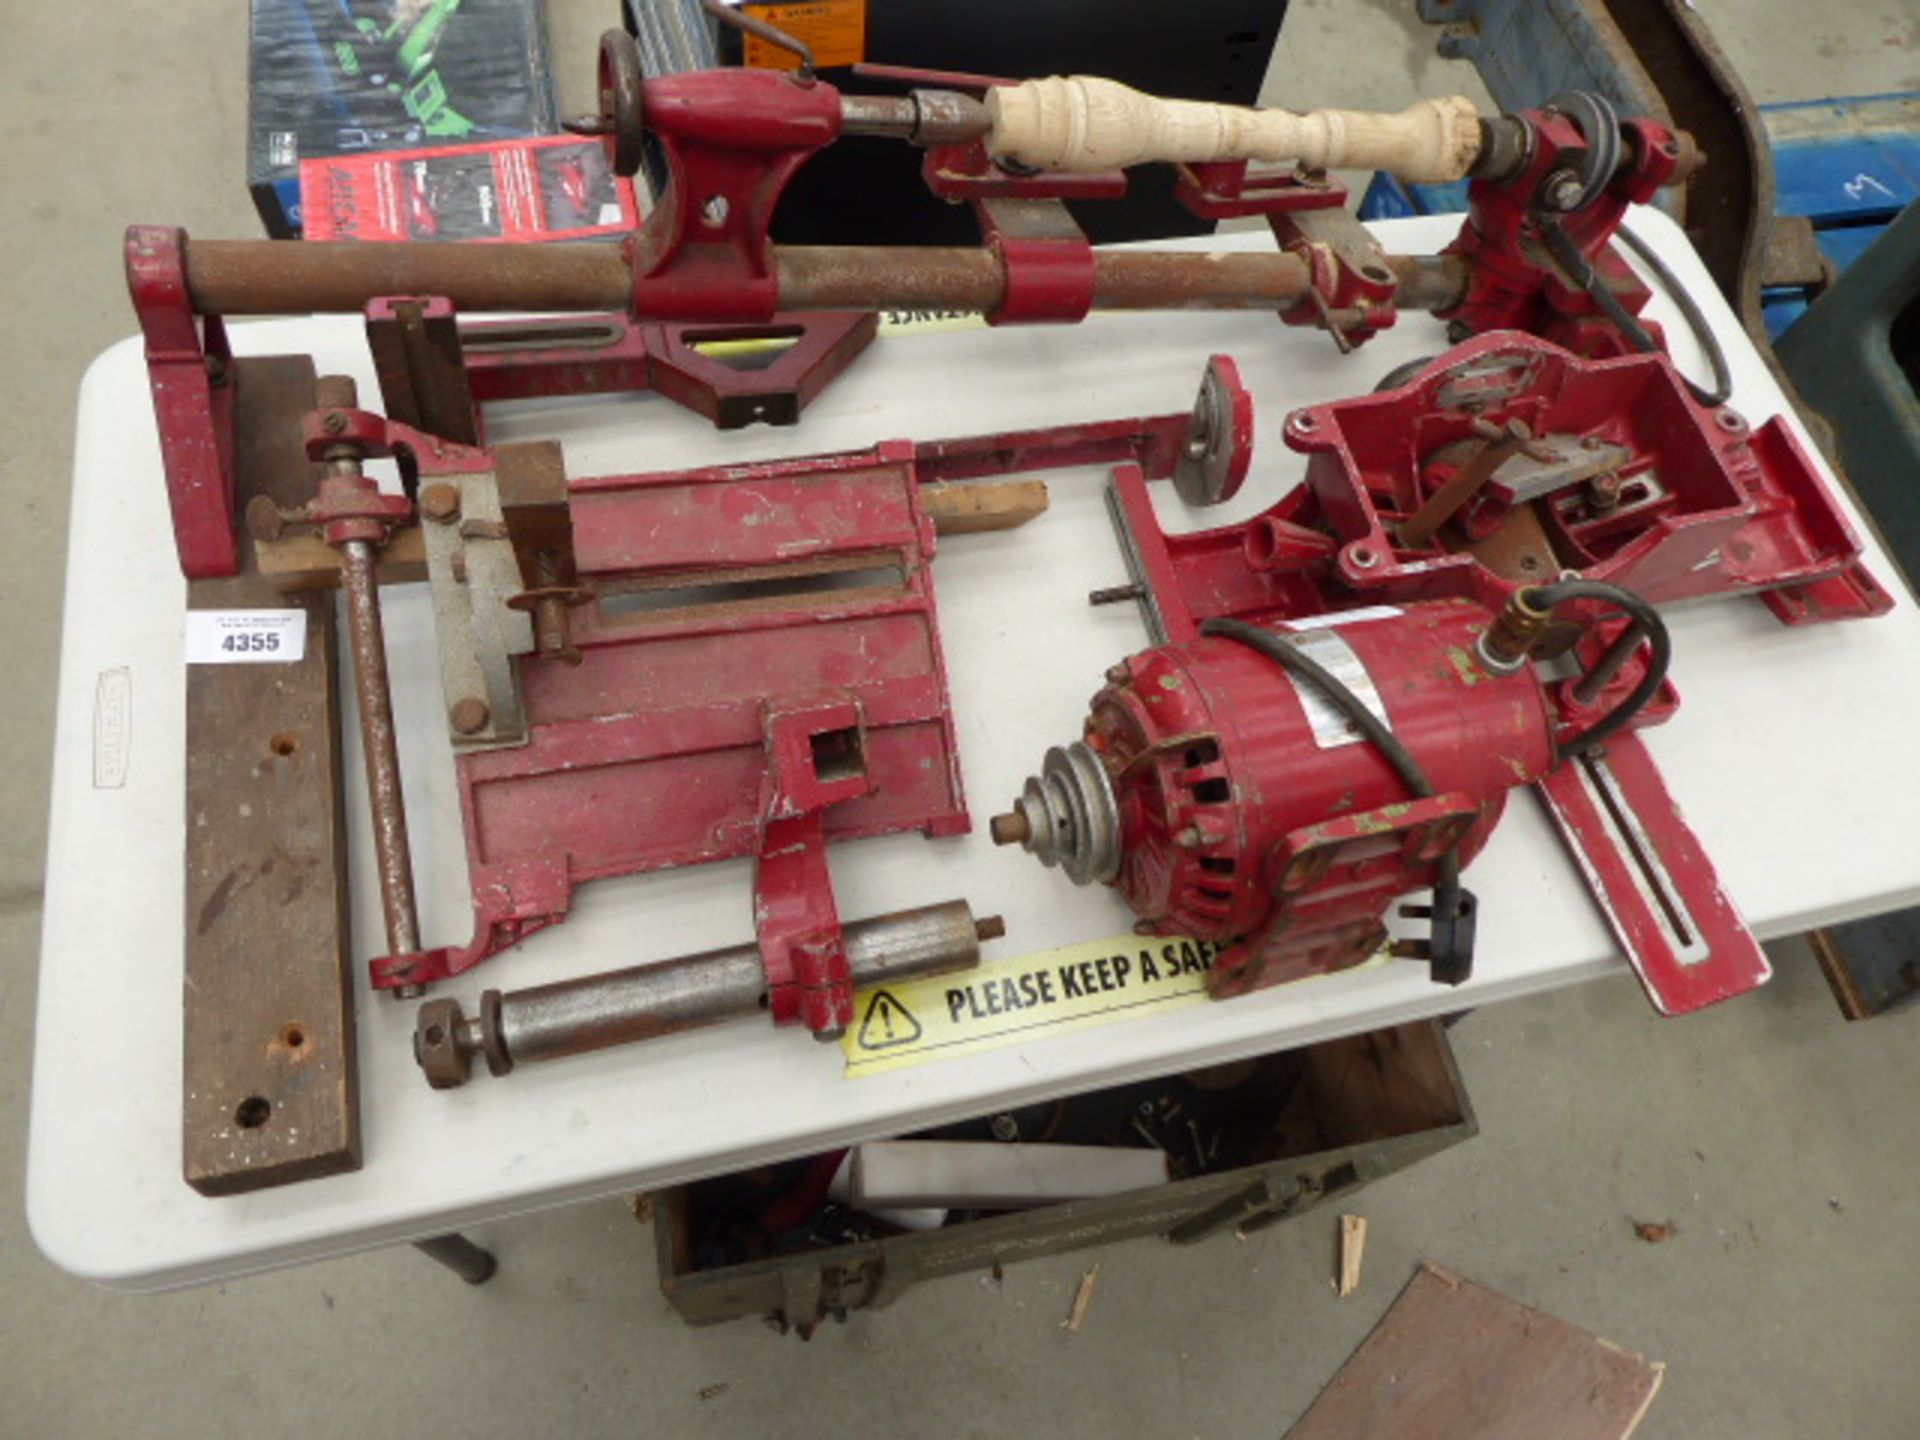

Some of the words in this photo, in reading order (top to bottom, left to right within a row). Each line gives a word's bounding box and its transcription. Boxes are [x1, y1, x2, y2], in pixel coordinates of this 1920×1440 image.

[221, 632, 280, 652] 4355
[945, 969, 1056, 1023] PLEASE
[1058, 955, 1131, 999] KEEP
[1138, 949, 1160, 983] A
[1160, 939, 1225, 977] SAF
